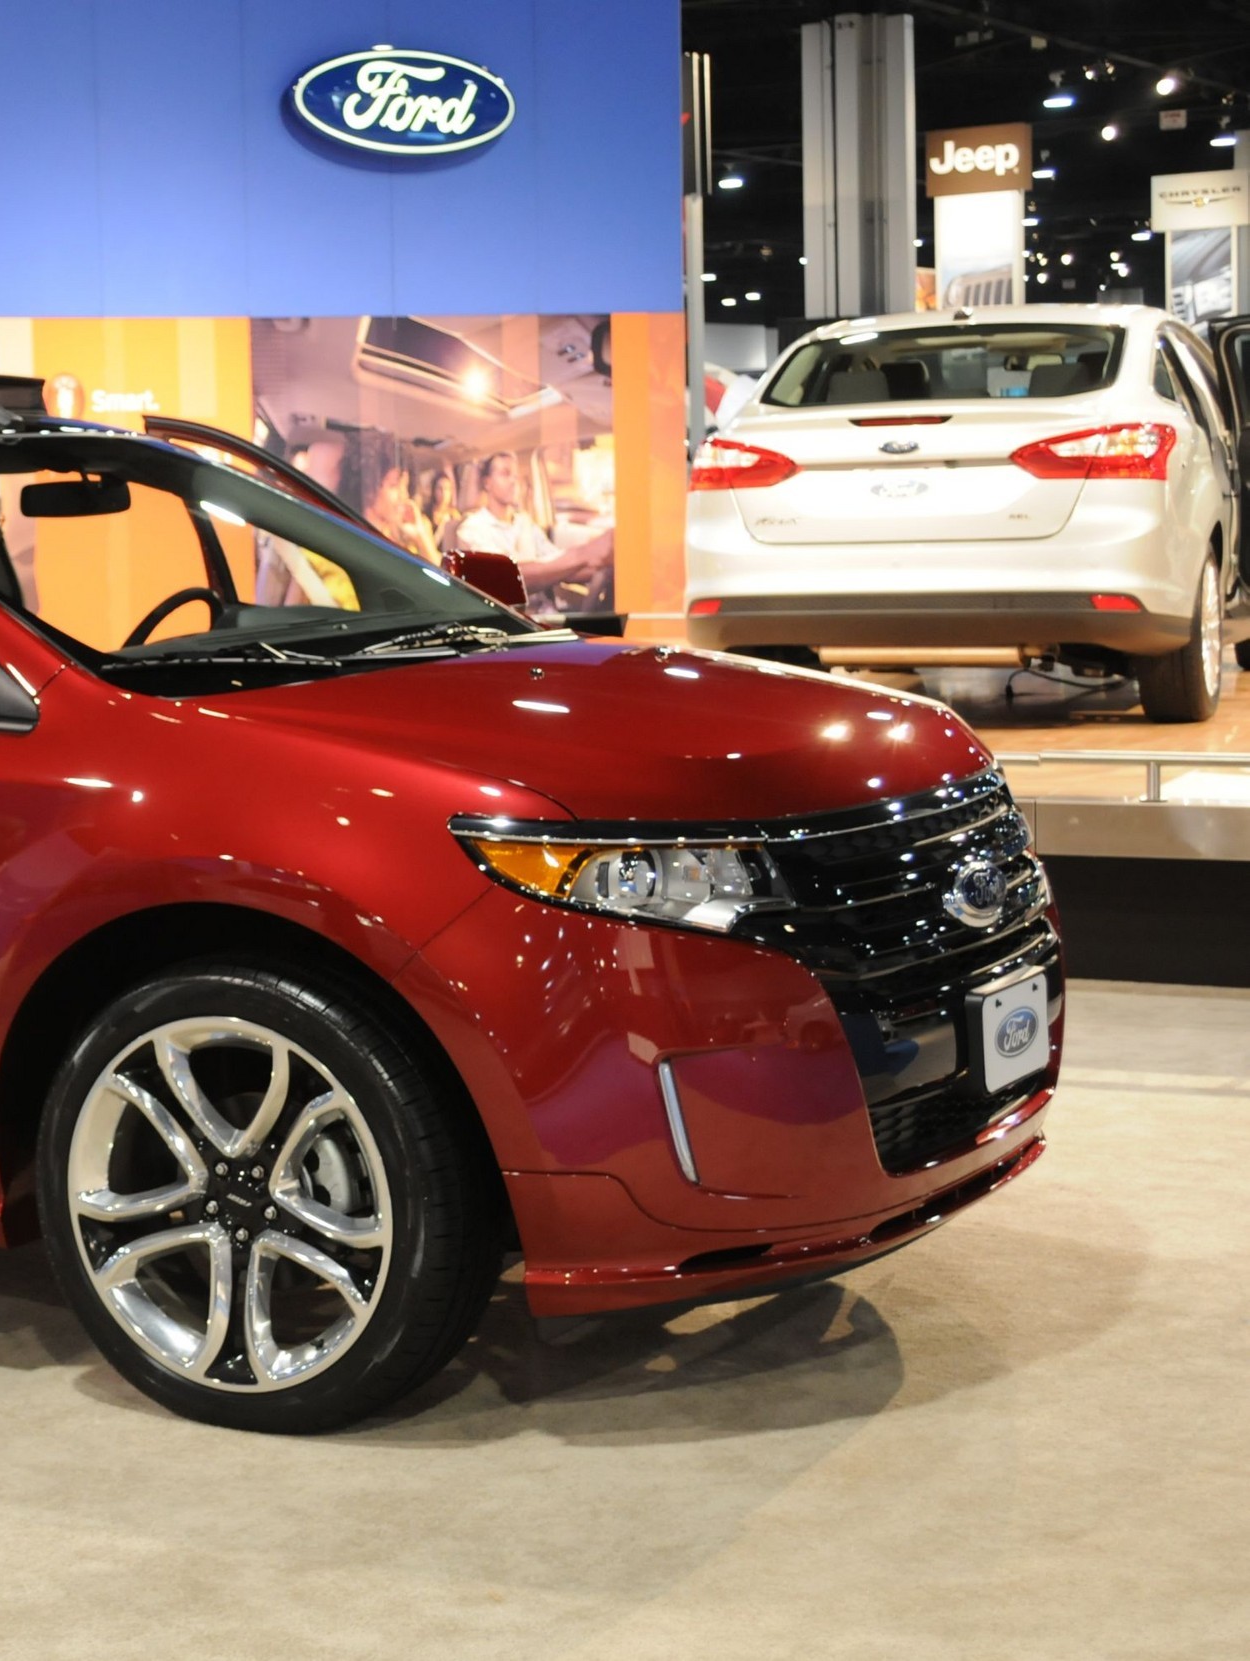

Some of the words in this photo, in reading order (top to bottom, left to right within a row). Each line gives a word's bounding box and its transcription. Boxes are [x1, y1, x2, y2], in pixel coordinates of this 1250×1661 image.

[343, 60, 478, 135] Ford
[930, 140, 1020, 175] Jeep
[1159, 186, 1241, 198] CHRYSLER
[1003, 1014, 1030, 1051] Ford
